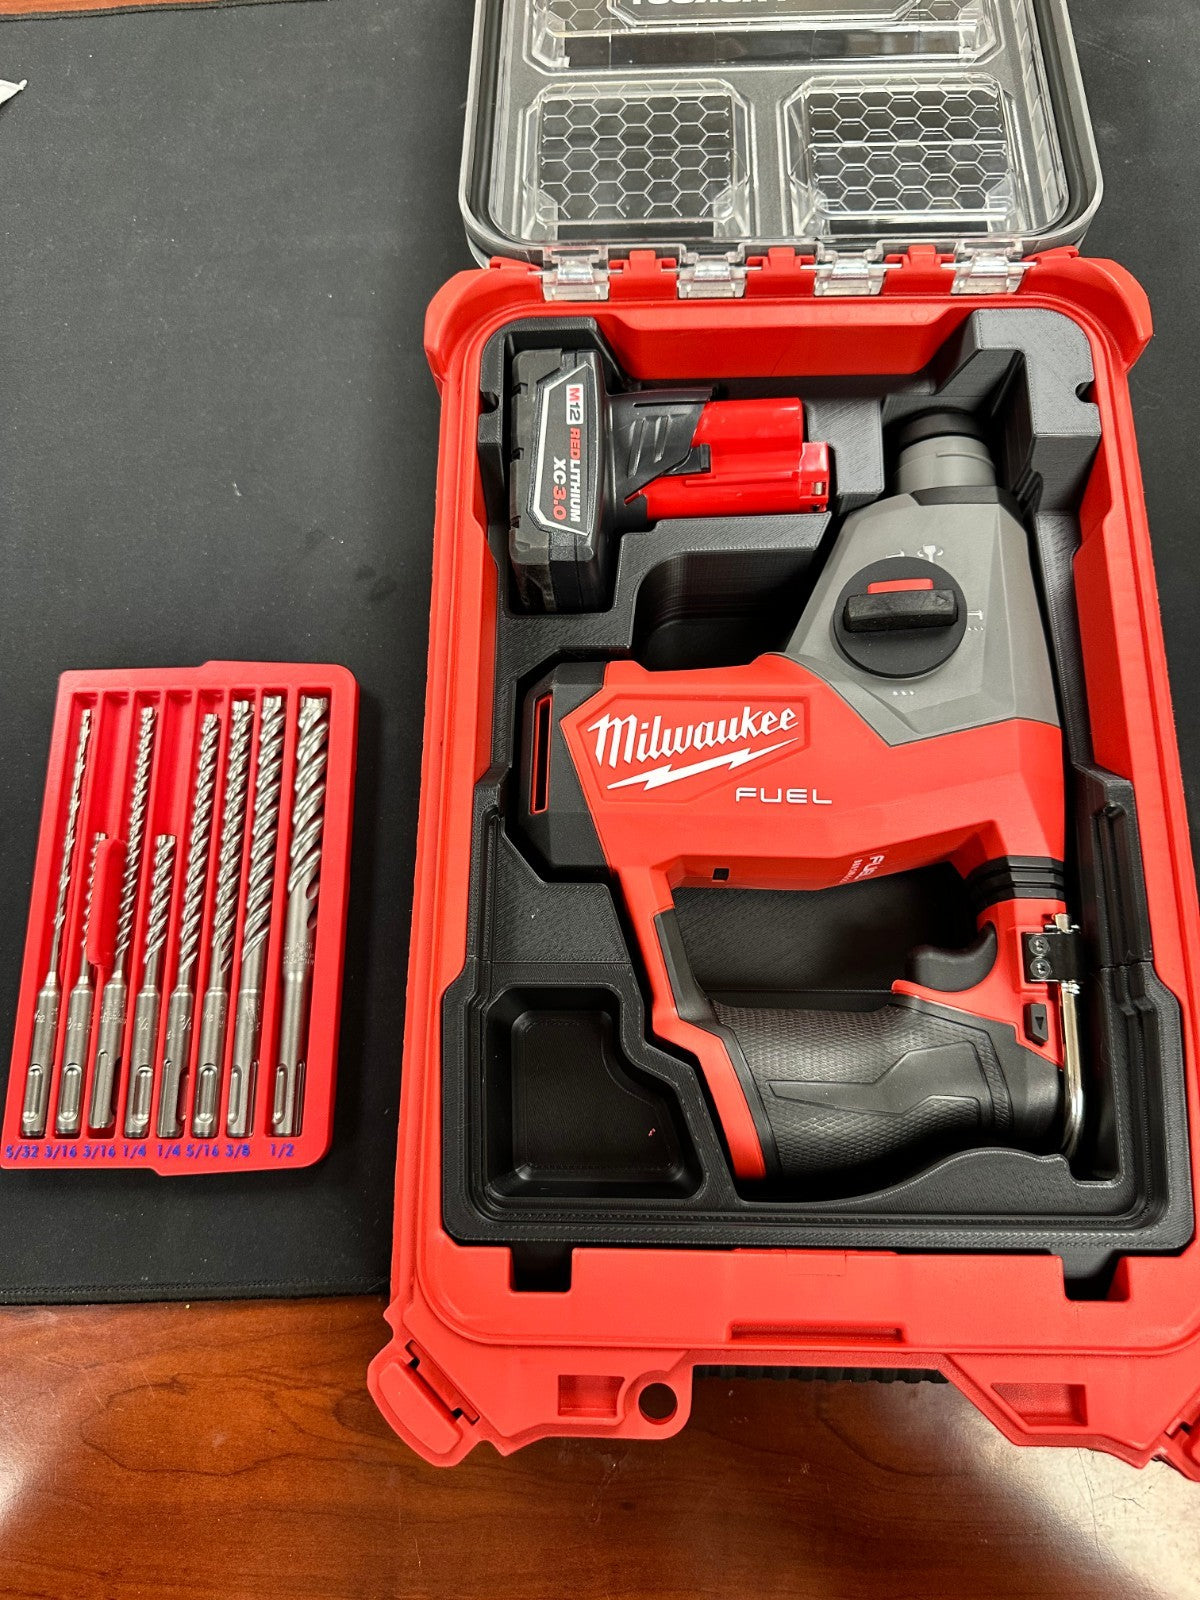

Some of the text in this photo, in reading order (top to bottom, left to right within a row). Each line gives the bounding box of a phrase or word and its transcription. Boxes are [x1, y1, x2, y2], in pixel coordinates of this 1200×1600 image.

[568, 387, 582, 523] M12 REDLITHIUM
[587, 706, 799, 769] Milwaukee
[735, 786, 833, 805] FUEL
[6, 1142, 295, 1160] 5/32 3/16 3/16 1/4 1/4 5/16 3/8 1/2
